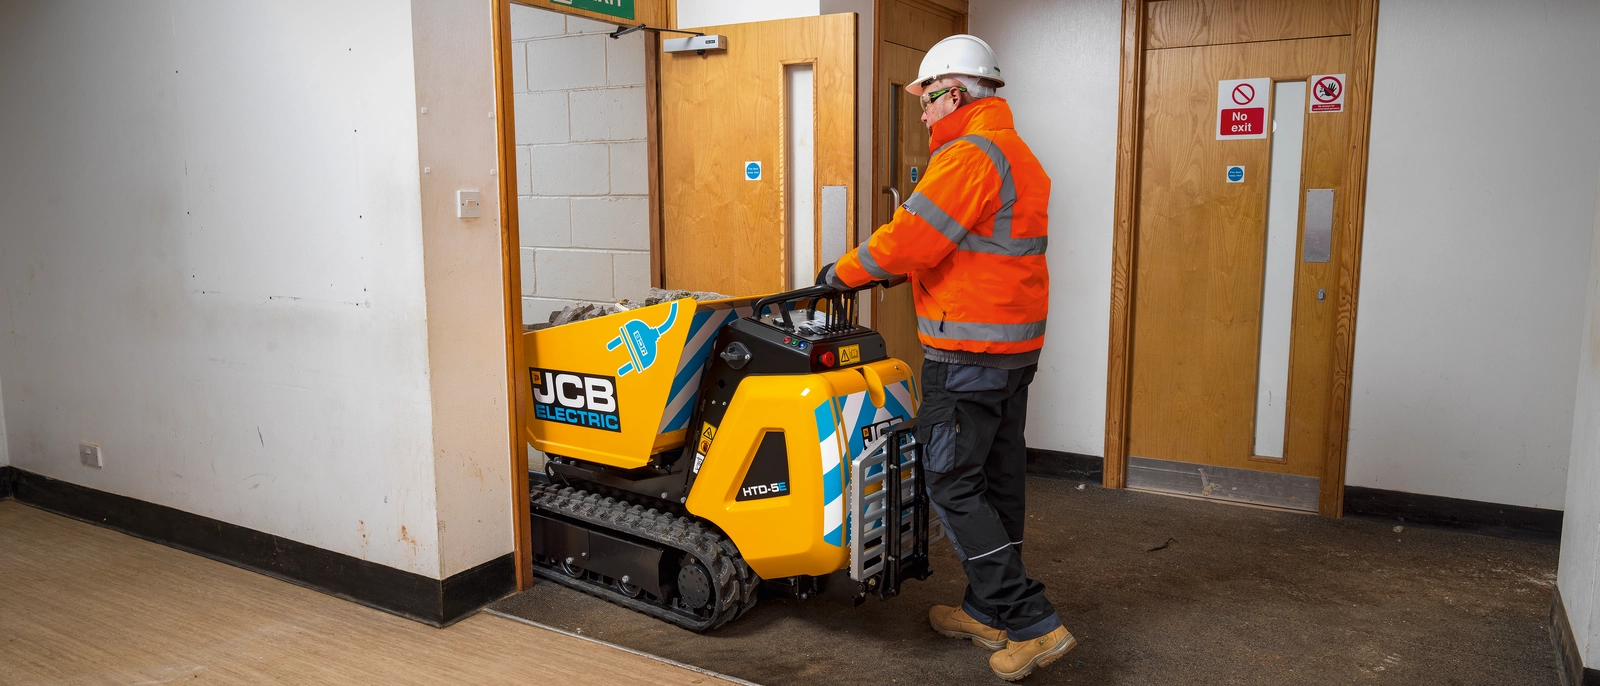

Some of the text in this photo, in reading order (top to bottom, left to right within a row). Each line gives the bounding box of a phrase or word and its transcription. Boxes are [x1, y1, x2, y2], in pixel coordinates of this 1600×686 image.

[1232, 111, 1248, 121] No
[1231, 122, 1252, 132] exit
[533, 372, 616, 413] JCB
[535, 404, 619, 430] ELECTRIC
[742, 481, 787, 497] HTD-5E
